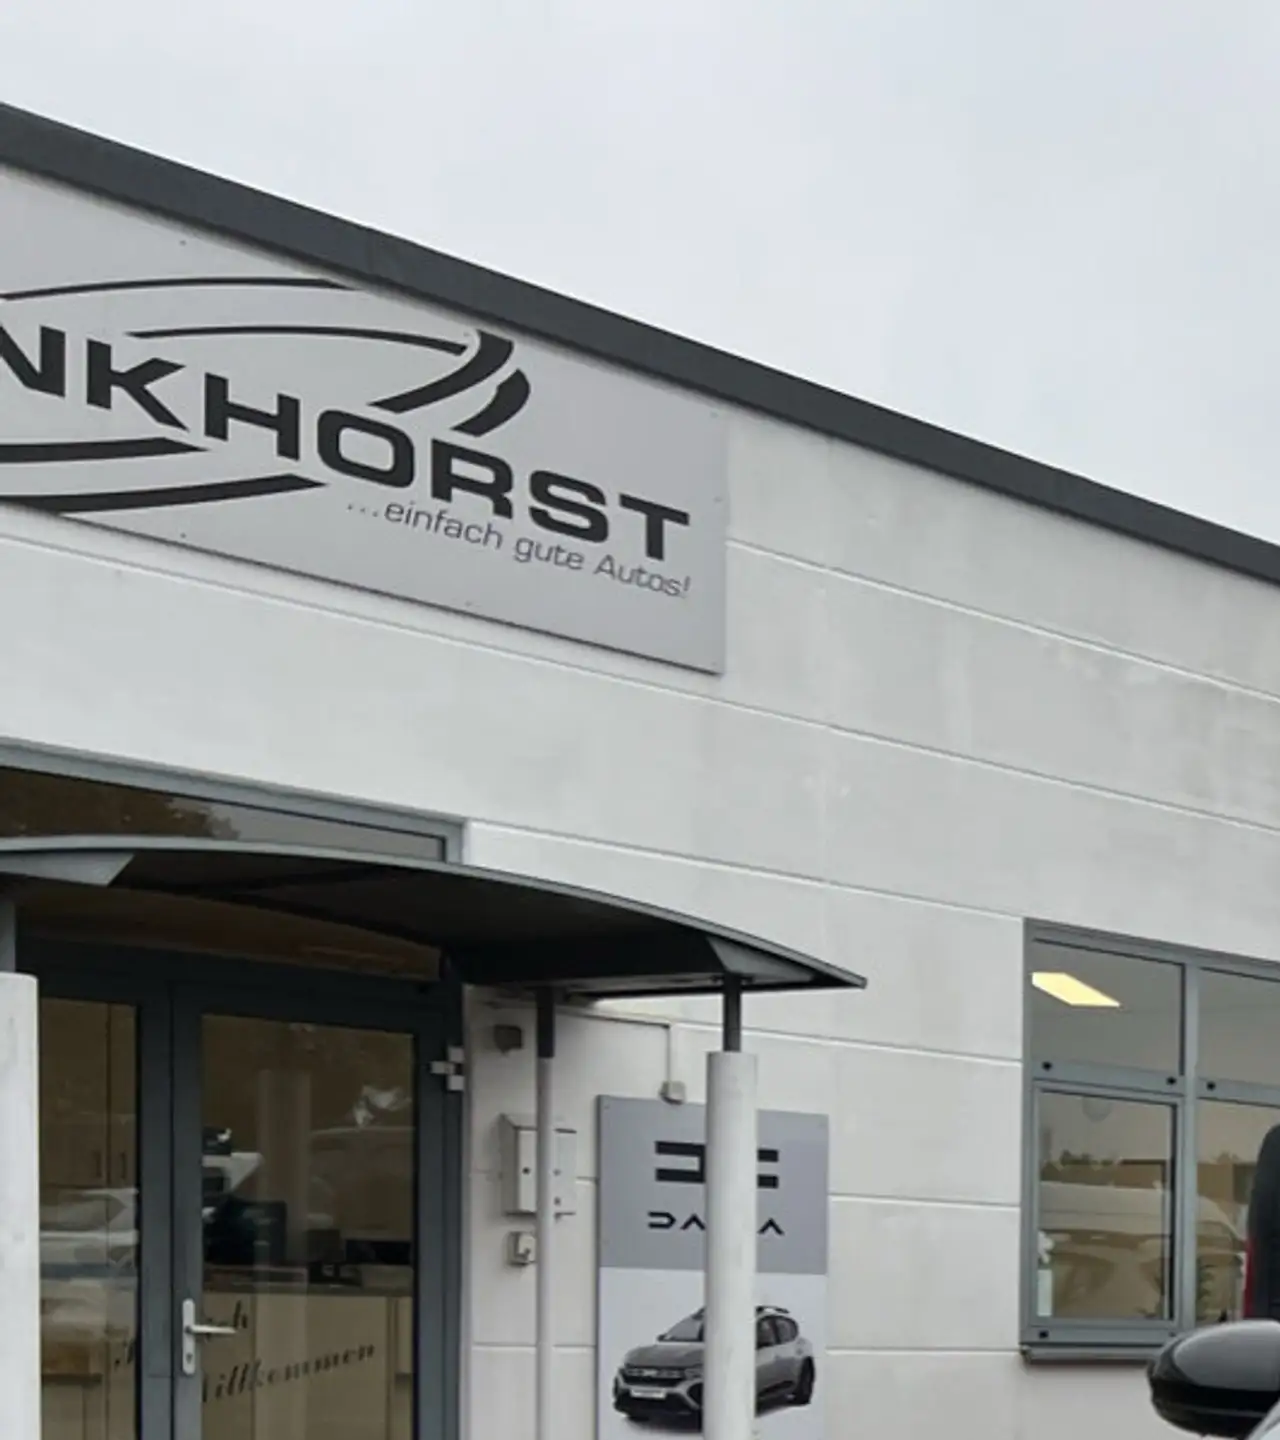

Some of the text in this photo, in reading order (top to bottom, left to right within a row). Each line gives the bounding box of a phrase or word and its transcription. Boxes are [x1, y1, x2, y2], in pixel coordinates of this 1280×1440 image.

[513, 536, 586, 564] gute
[594, 553, 692, 600] Autos!
[647, 1211, 785, 1236] DAA
[202, 1344, 375, 1402] illkommen
